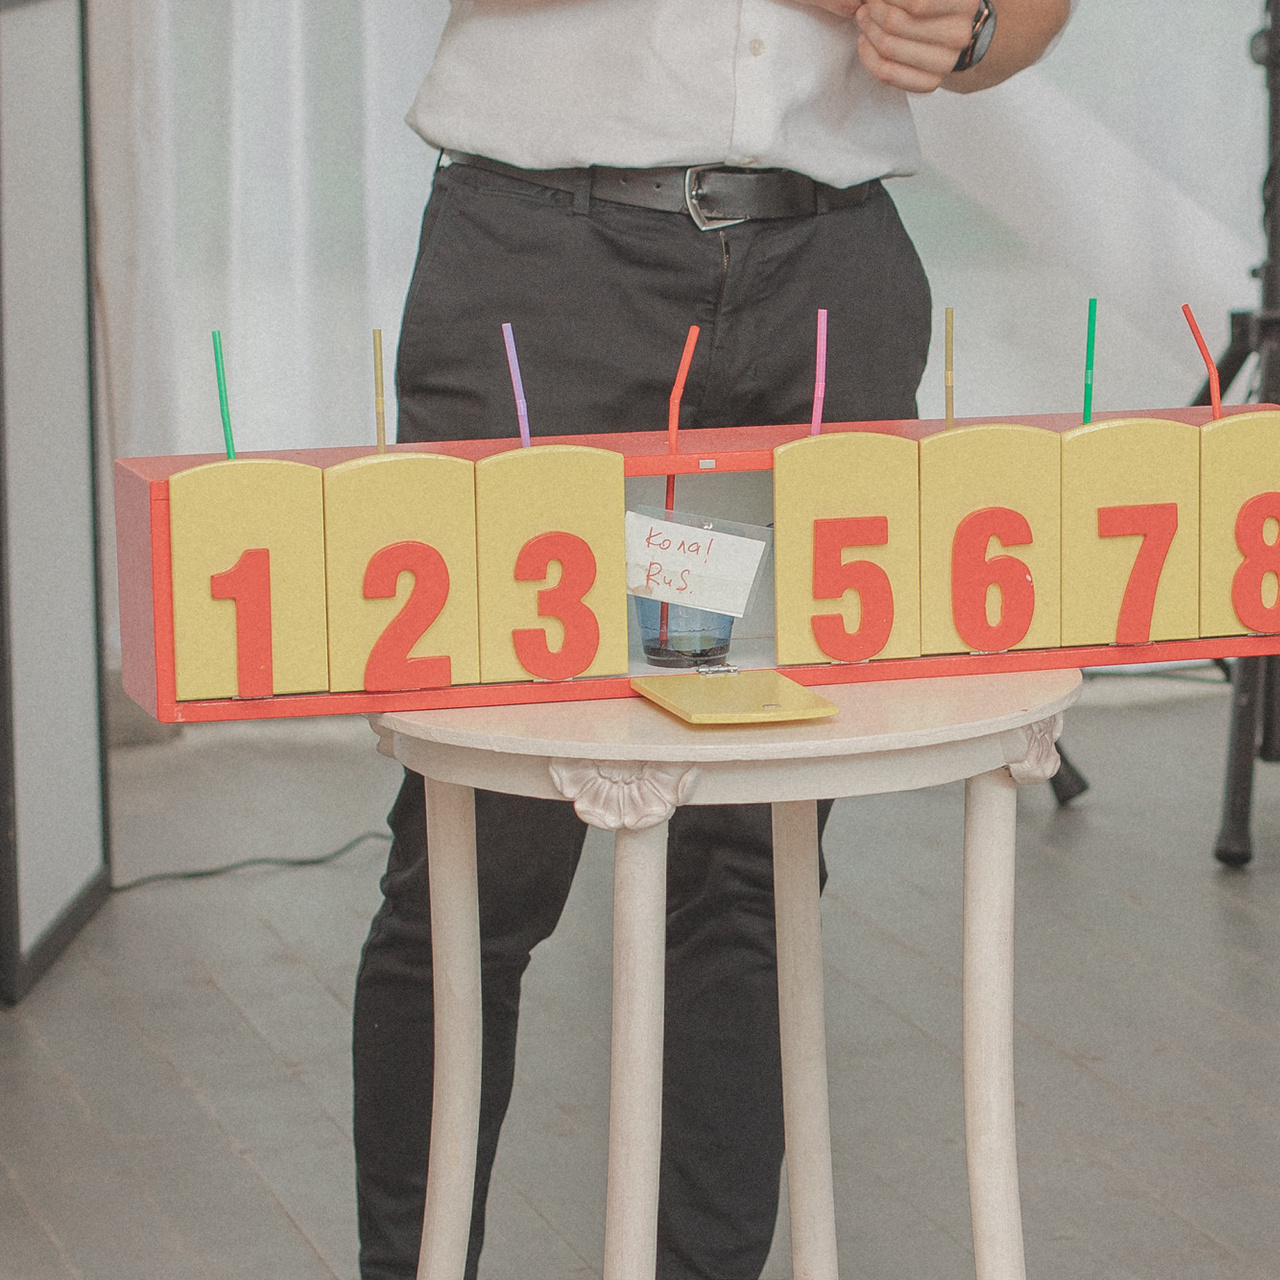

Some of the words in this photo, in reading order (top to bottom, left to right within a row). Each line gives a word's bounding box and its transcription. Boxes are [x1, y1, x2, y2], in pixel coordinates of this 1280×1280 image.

[210, 548, 274, 697] 1
[362, 540, 452, 691] 2
[511, 530, 600, 681] 3
[810, 516, 894, 663] 5
[950, 506, 1034, 654] 6
[1097, 503, 1178, 644] 7
